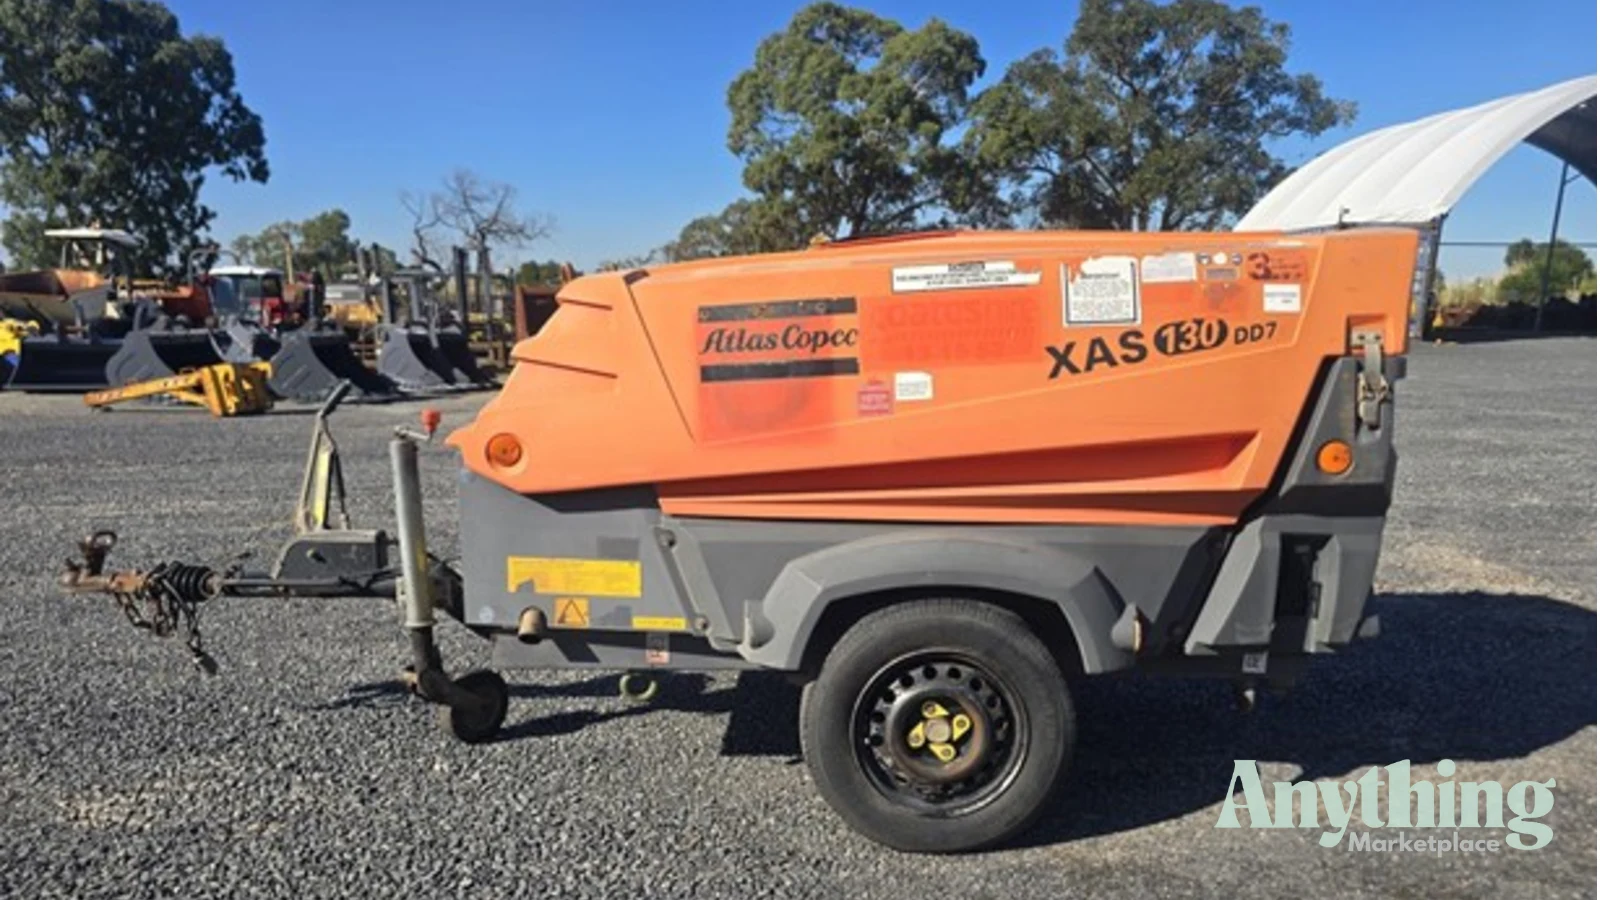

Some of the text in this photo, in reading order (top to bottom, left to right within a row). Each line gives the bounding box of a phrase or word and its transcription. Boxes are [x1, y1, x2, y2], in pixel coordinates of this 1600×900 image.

[699, 317, 779, 354] Atlas
[1044, 329, 1148, 379] XAS
[1160, 320, 1221, 355] 130
[1234, 322, 1278, 345] DD7
